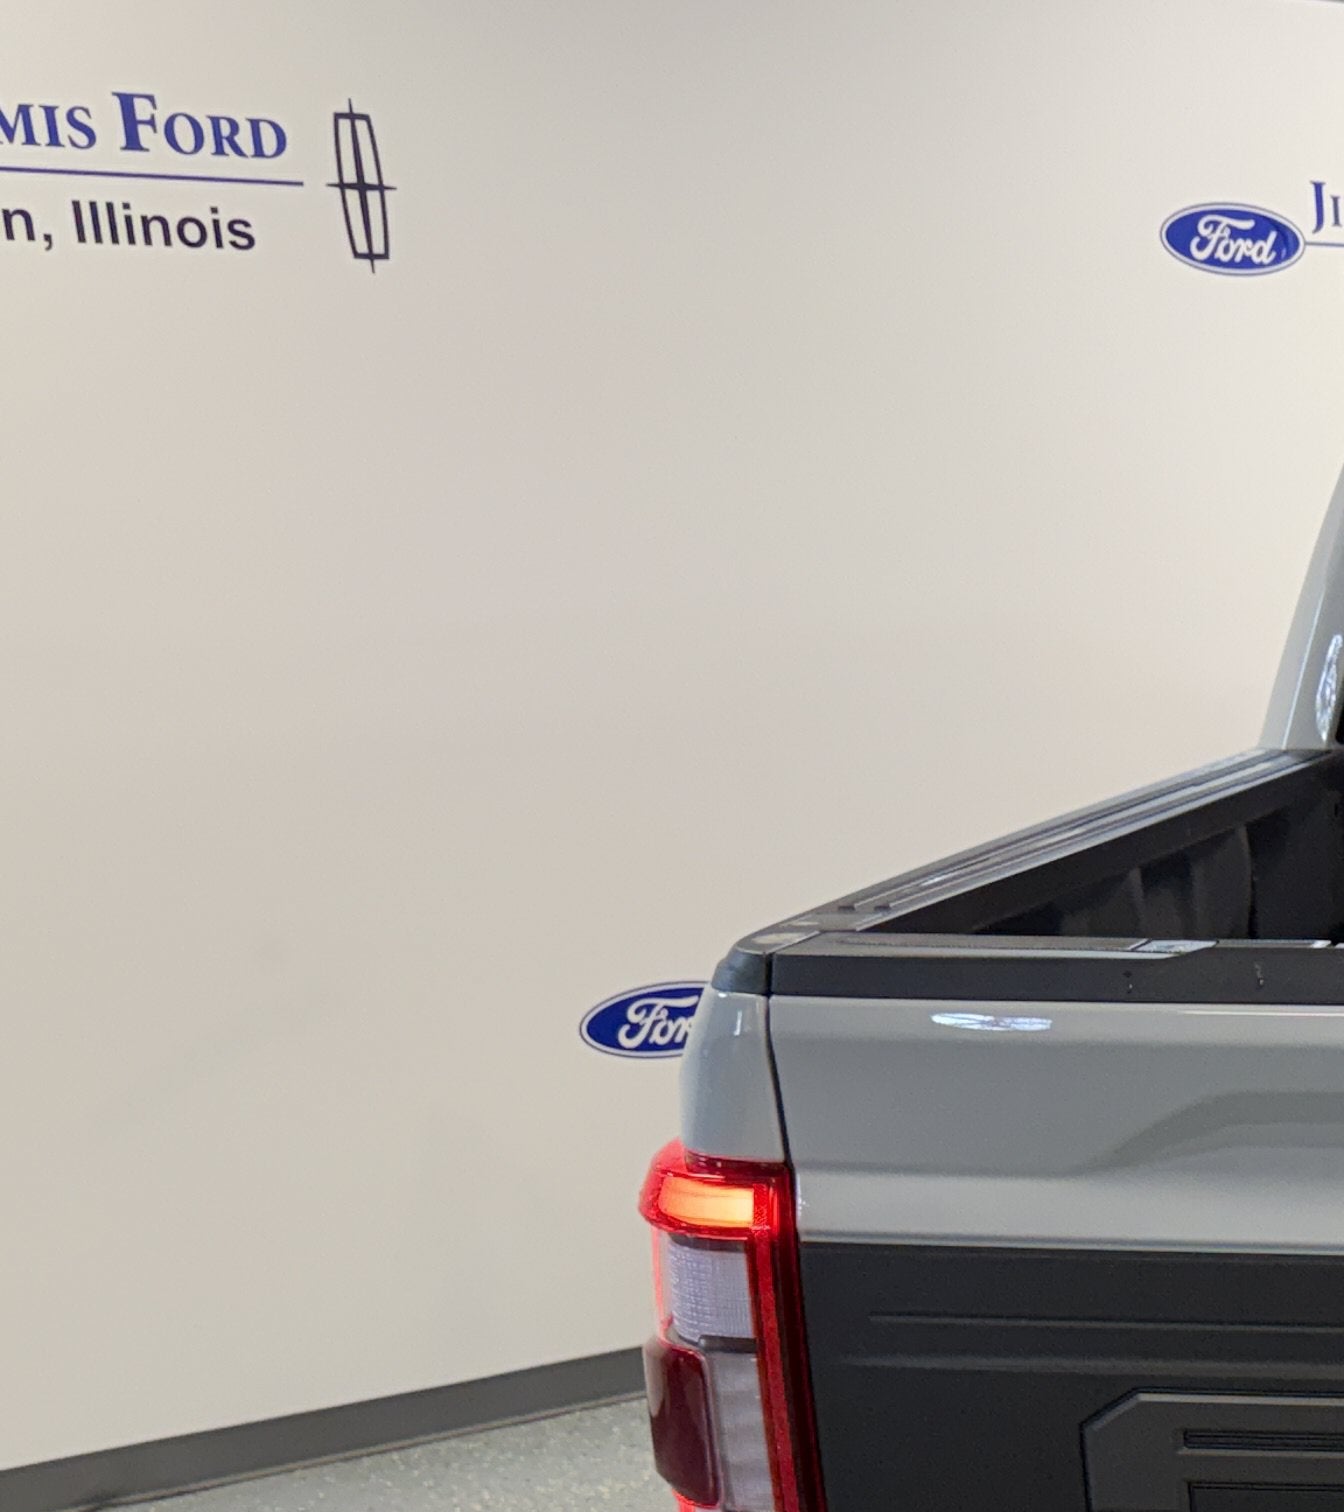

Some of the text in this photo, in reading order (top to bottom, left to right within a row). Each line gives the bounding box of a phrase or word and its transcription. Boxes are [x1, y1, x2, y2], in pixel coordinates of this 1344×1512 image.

[111, 91, 288, 159] FORD
[71, 200, 256, 251] Illinois
[1190, 214, 1277, 264] Ford
[618, 995, 699, 1049] For
